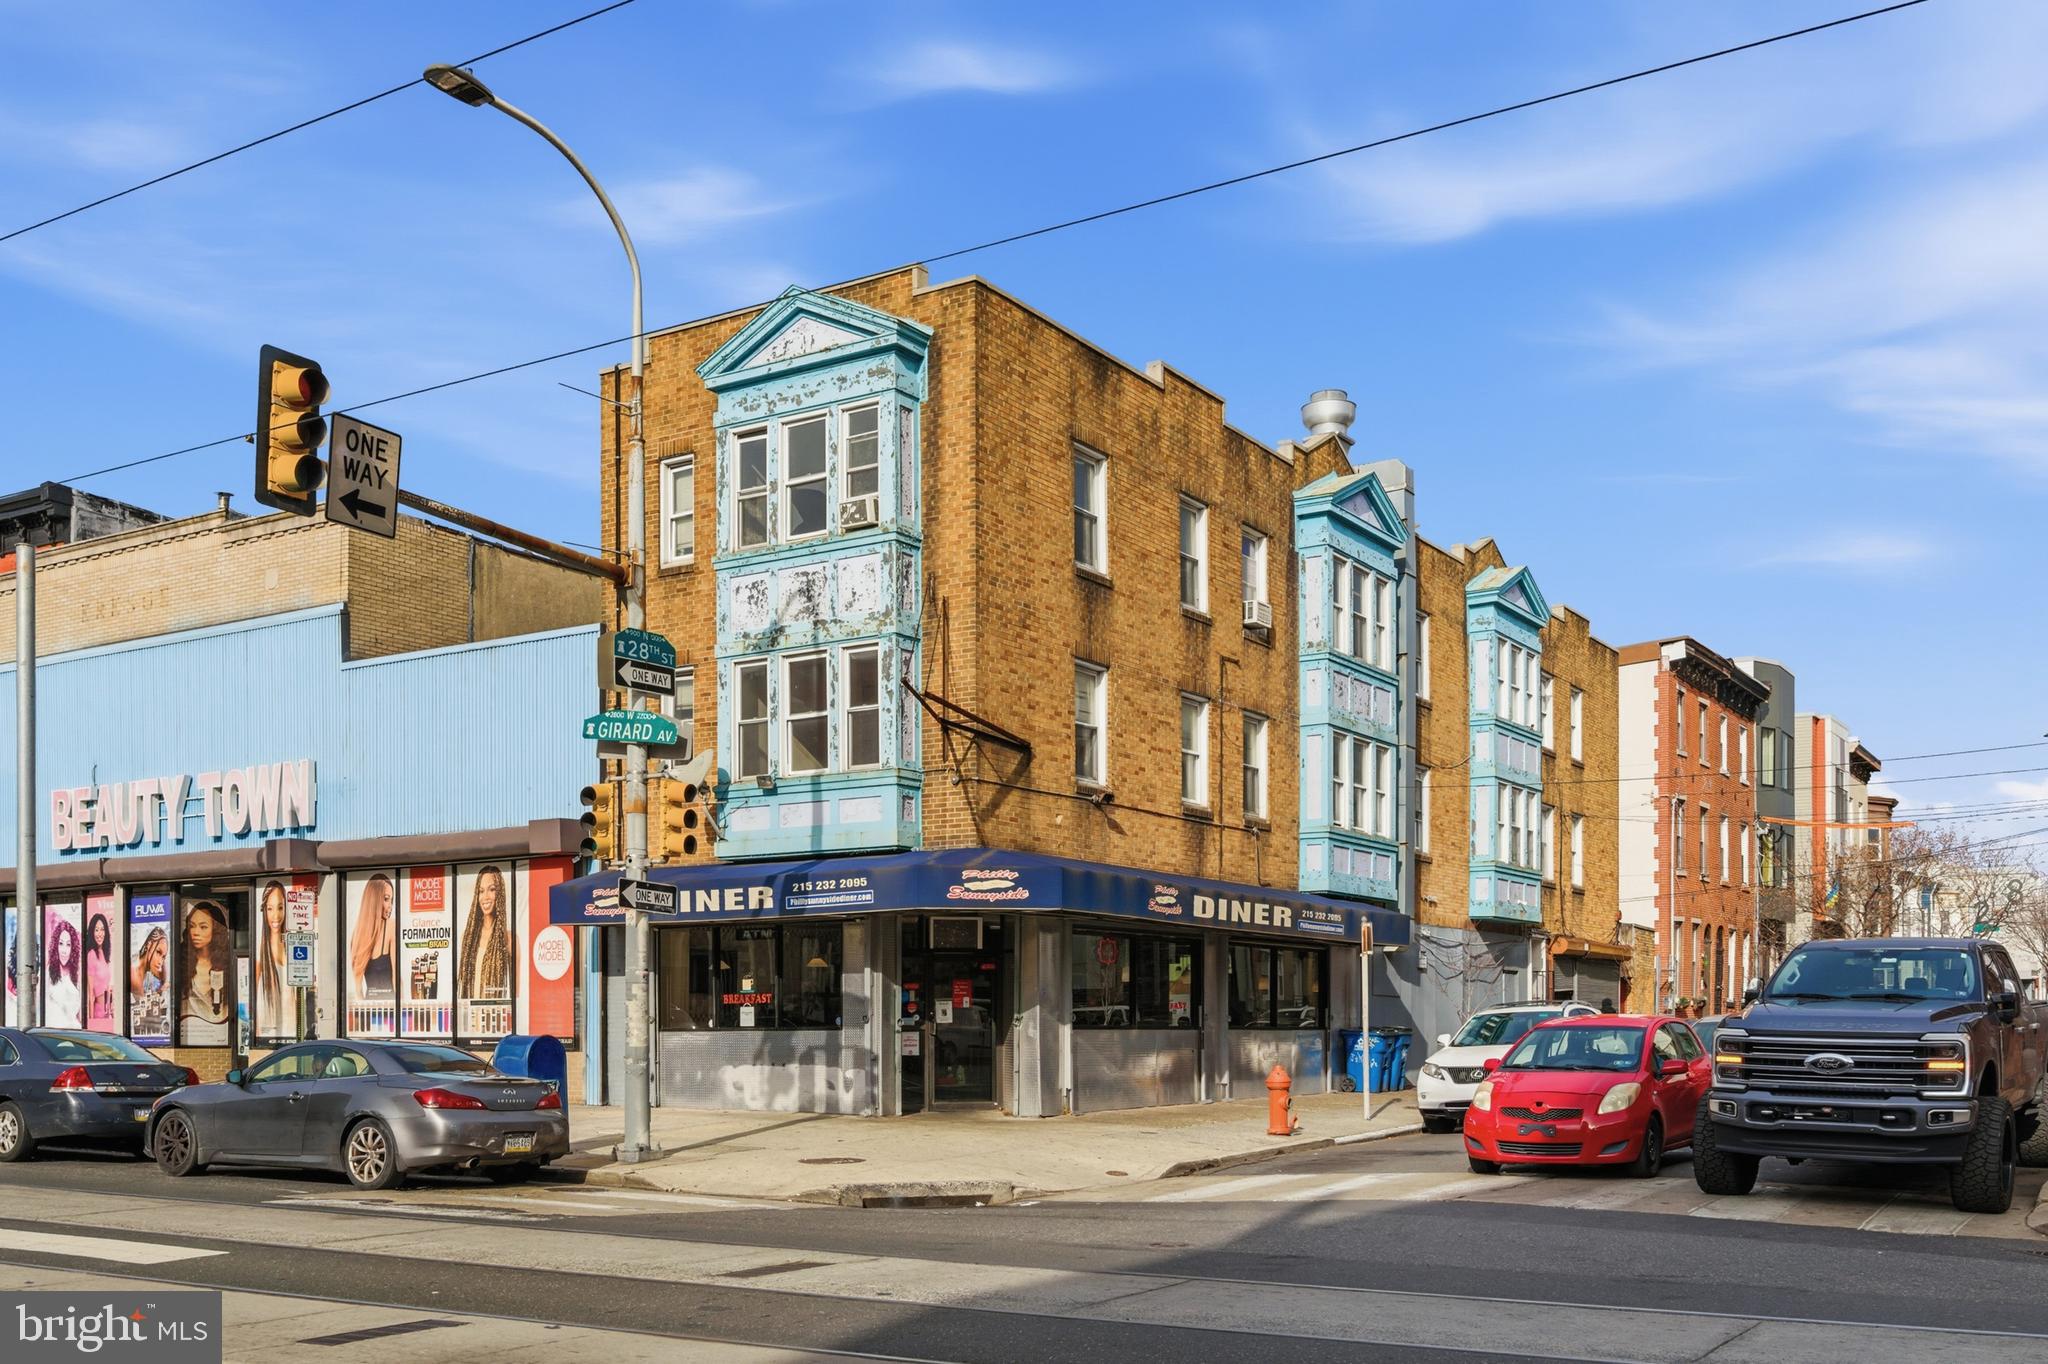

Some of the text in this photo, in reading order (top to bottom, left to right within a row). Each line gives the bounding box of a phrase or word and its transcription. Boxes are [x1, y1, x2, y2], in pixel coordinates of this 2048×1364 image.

[346, 429, 388, 463] ONE
[343, 455, 389, 490] WAY
[643, 632, 649, 640] N
[628, 640, 675, 666] 28TH ST
[632, 669, 669, 687] ONE WAY
[627, 711, 635, 720] W
[598, 722, 673, 742] GIRARD AV
[51, 758, 317, 850] BEAUTY TOWN
[413, 878, 442, 890] MODEL
[792, 877, 868, 892] 215 232 2095
[413, 890, 442, 902] MODEL
[635, 890, 671, 905] ONE WAY
[680, 886, 774, 914] INER
[946, 885, 1030, 902] Sunnyside
[135, 903, 165, 915] RUWA
[1193, 895, 1292, 928] DINER
[1302, 910, 1314, 919] 215
[402, 928, 451, 940] FORMATION
[538, 940, 565, 950] MODEL
[538, 951, 565, 961] MODEL
[723, 993, 773, 1004] BREAKFAST
